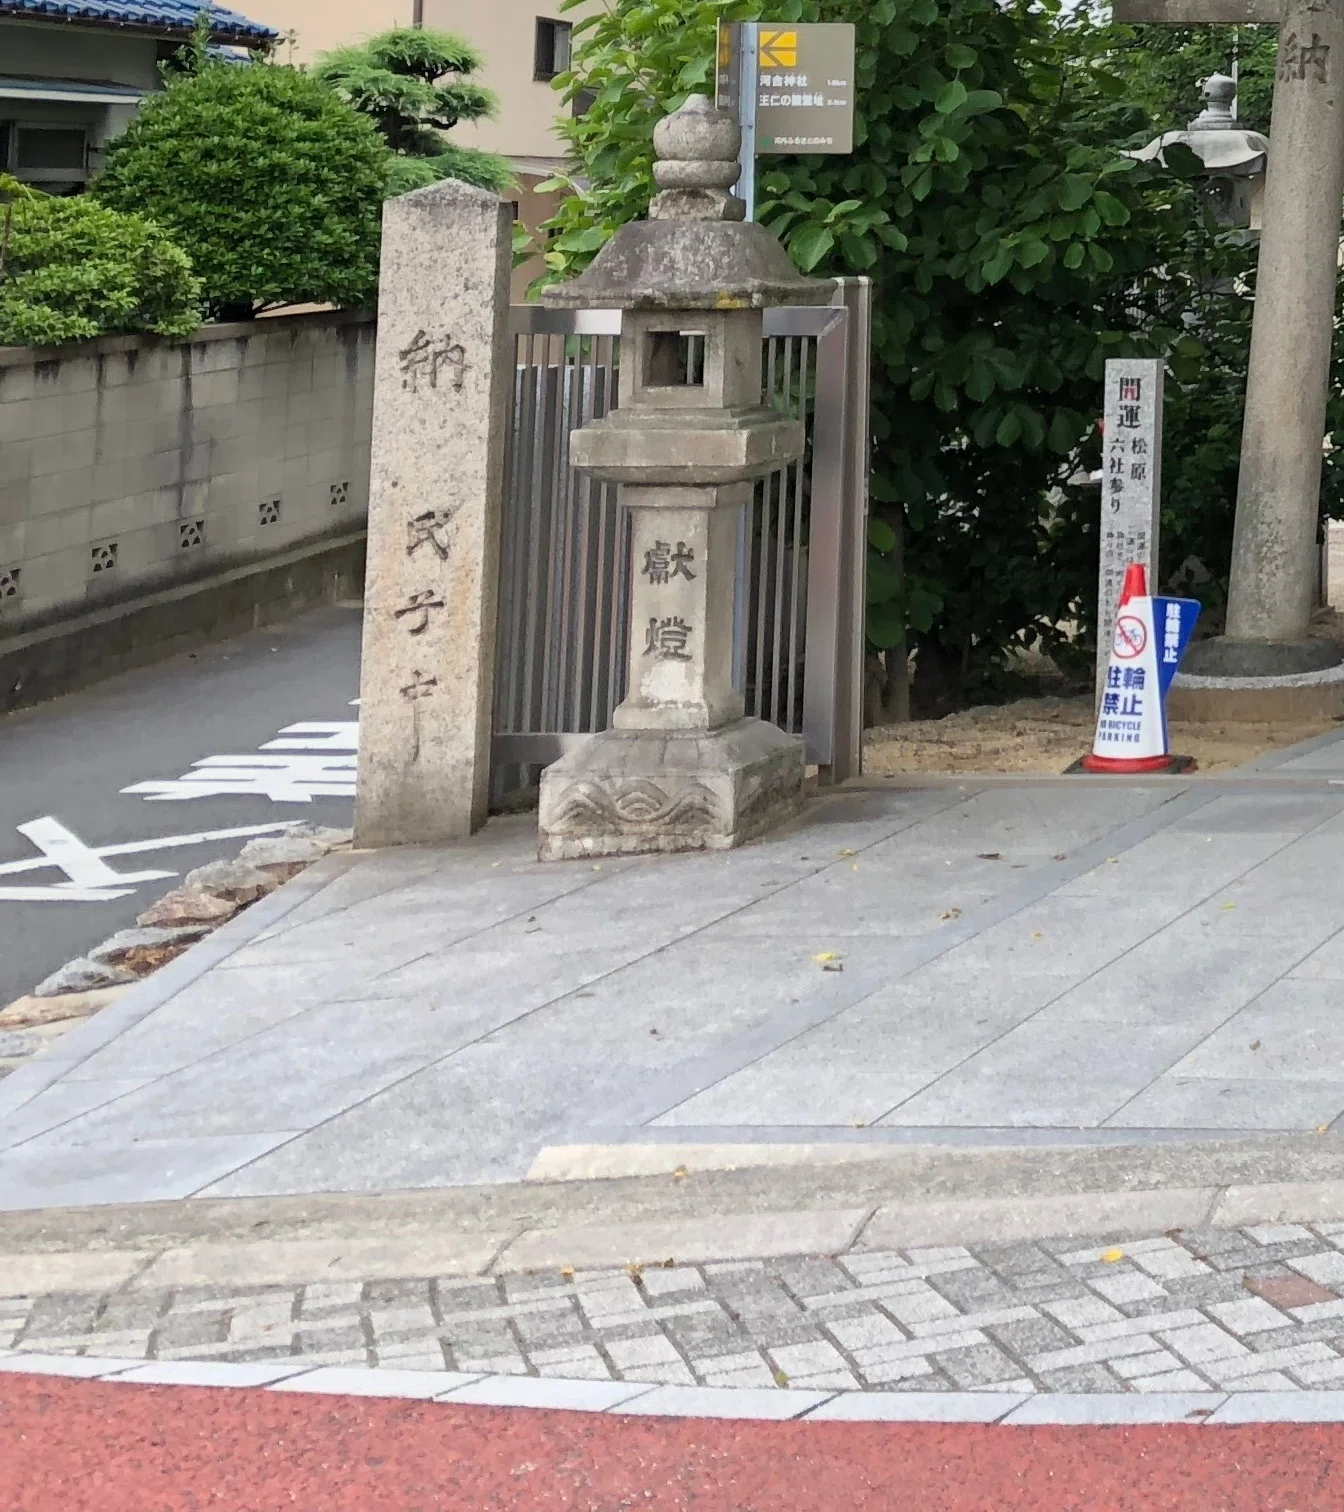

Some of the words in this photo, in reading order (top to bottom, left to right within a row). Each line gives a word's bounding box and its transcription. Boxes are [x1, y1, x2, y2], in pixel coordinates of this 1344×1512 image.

[398, 328, 473, 394] 納
[1116, 376, 1143, 430] 開運
[1130, 436, 1148, 481] 松原
[1107, 665, 1147, 691] 駐輪
[1102, 692, 1144, 717] 禁止
